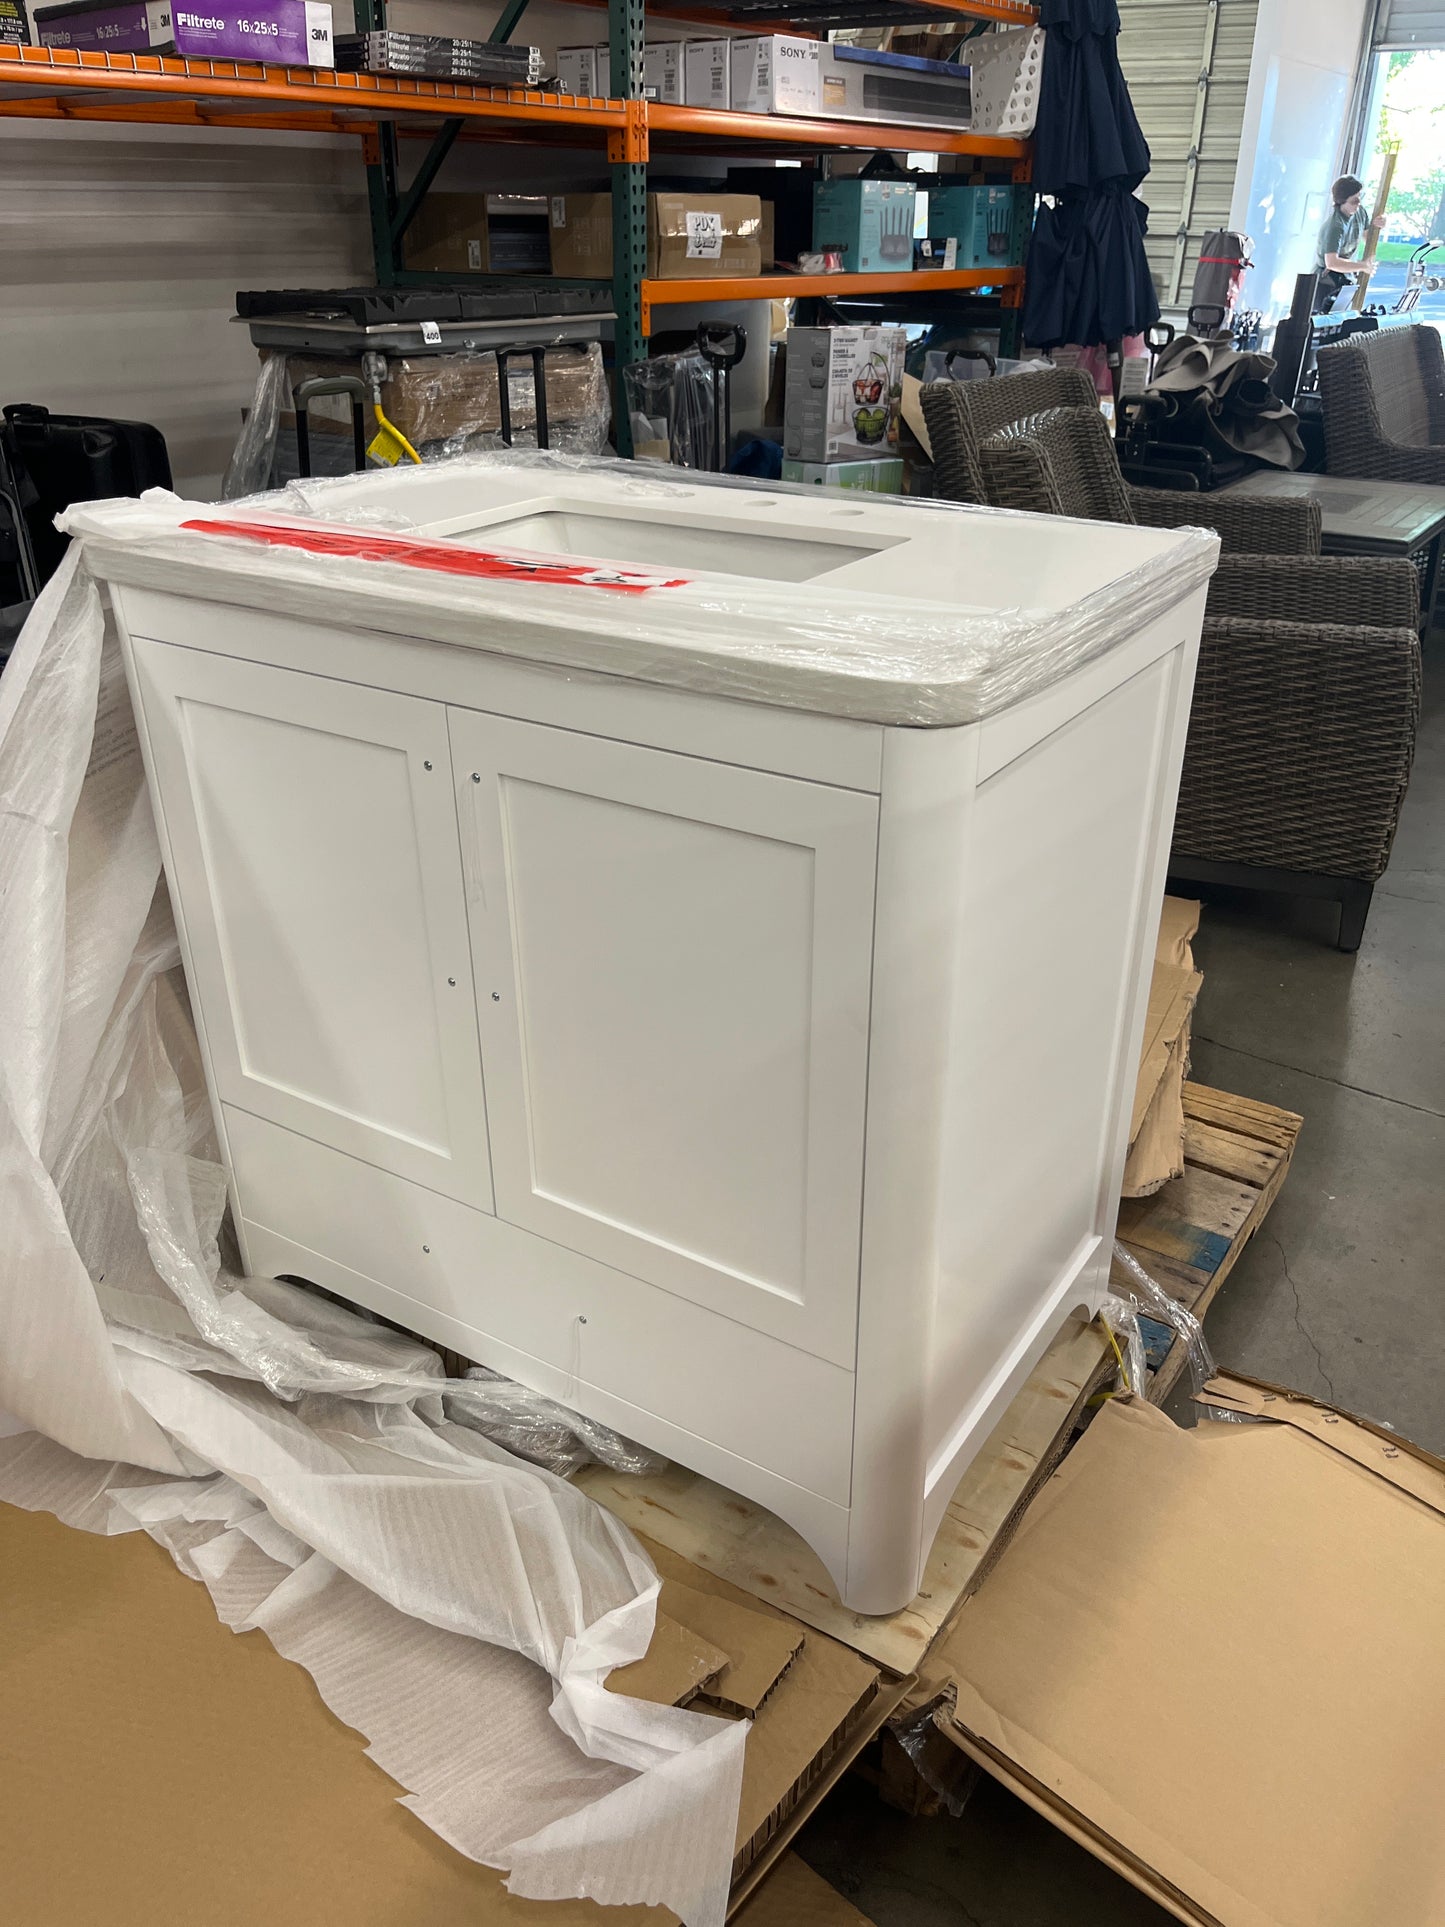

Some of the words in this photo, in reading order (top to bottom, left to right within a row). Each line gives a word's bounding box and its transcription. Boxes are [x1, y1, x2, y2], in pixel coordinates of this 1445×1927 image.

[160, 14, 170, 28] 3M
[176, 12, 225, 30] Filtrete
[237, 20, 278, 36] 16x25x5
[40, 31, 71, 46] Filtrete
[312, 28, 328, 41] 3M
[780, 46, 806, 59] SONY
